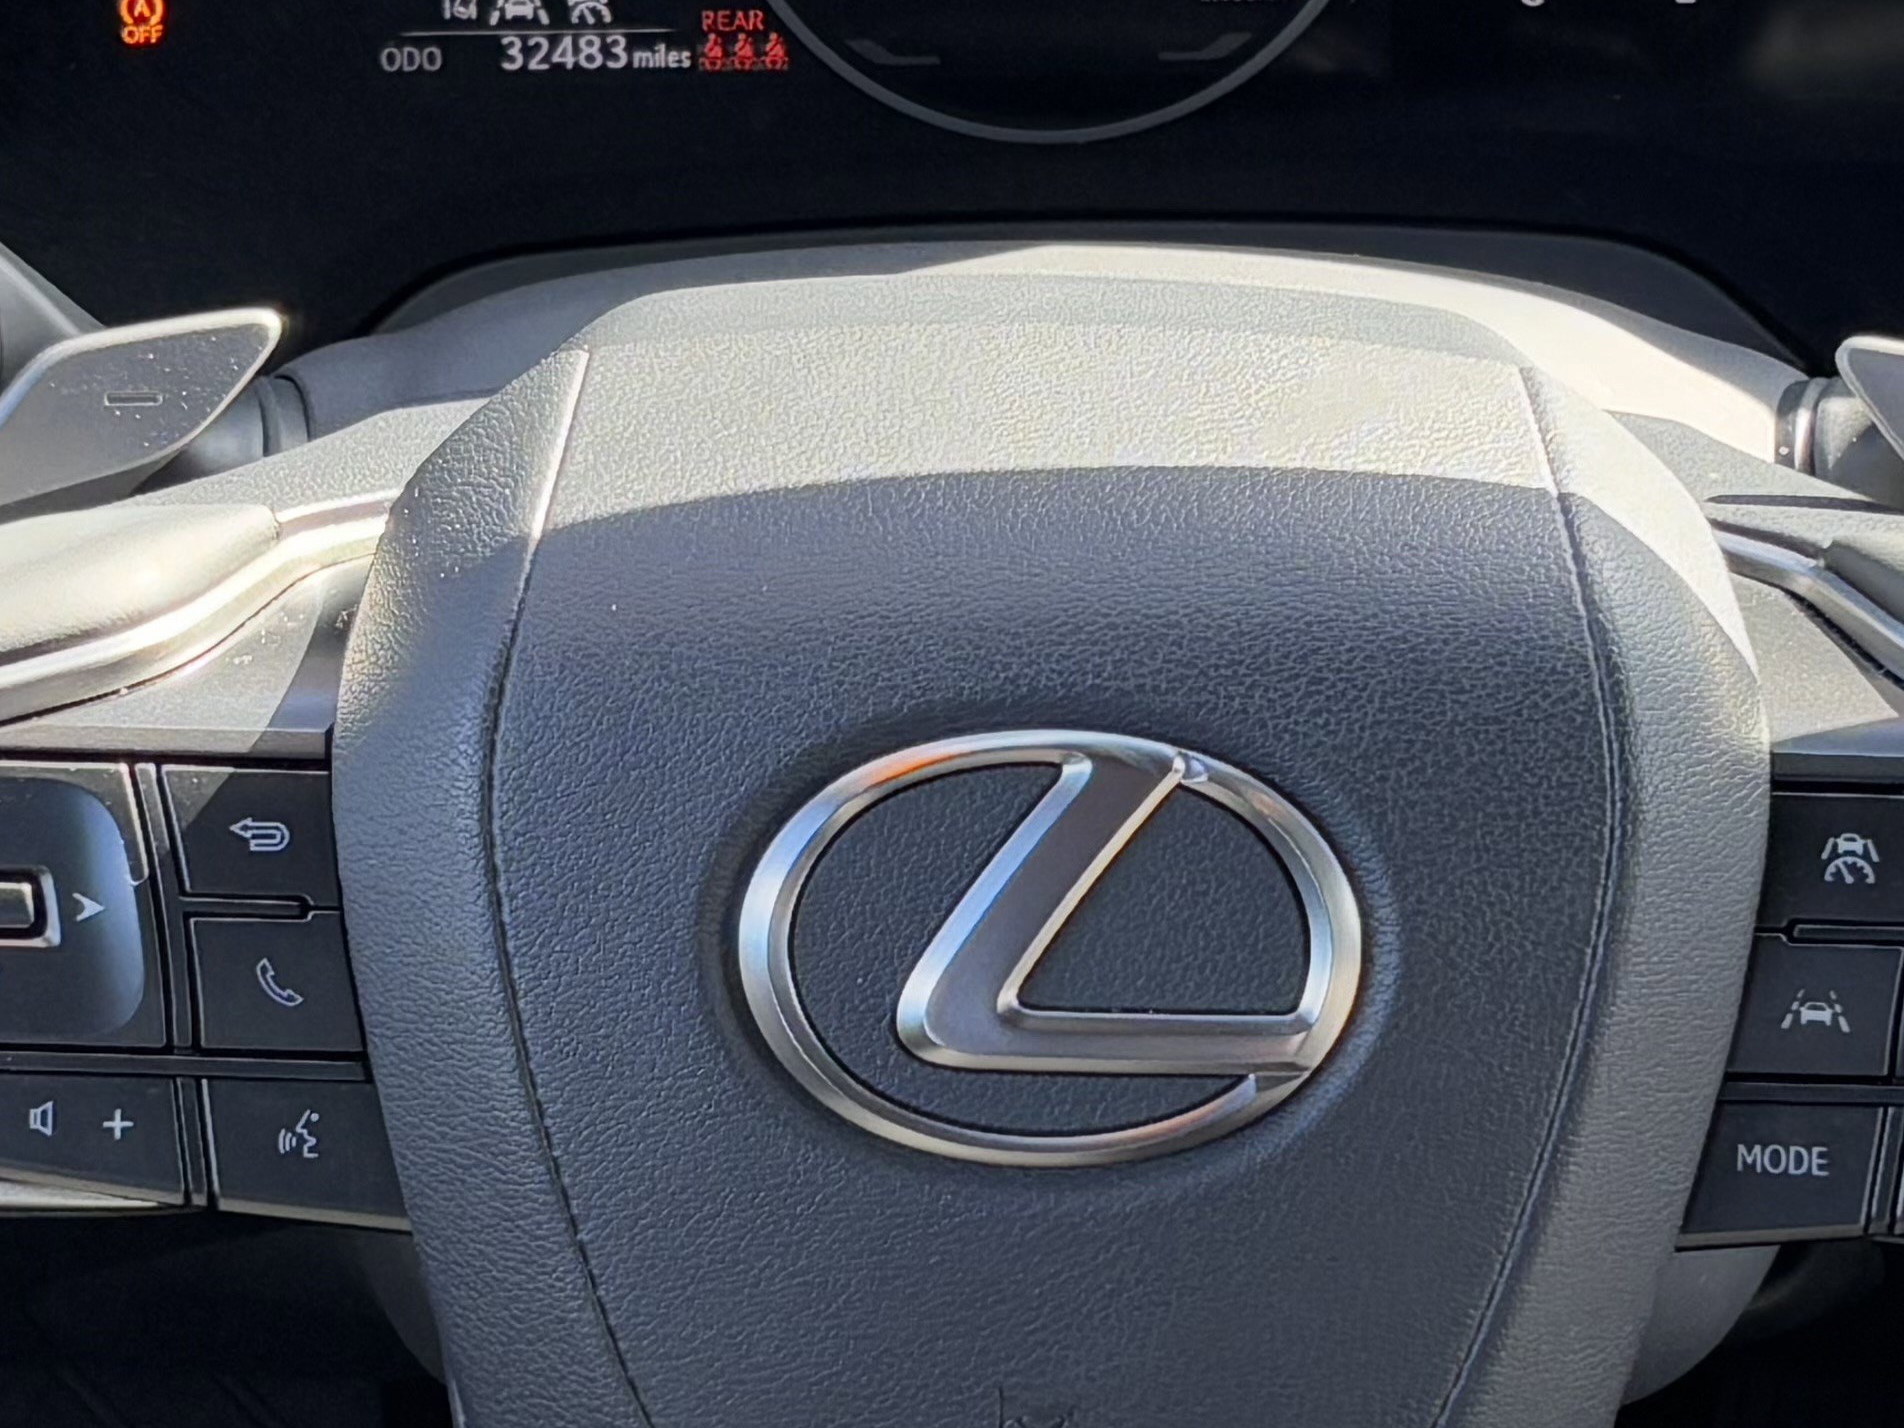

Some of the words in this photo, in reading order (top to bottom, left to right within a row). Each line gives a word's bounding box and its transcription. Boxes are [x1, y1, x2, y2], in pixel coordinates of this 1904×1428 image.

[702, 9, 764, 31] REAR
[121, 24, 164, 45] OFF
[500, 35, 629, 70] 32483
[632, 43, 692, 69] miles
[1737, 1144, 1829, 1177] MODE
